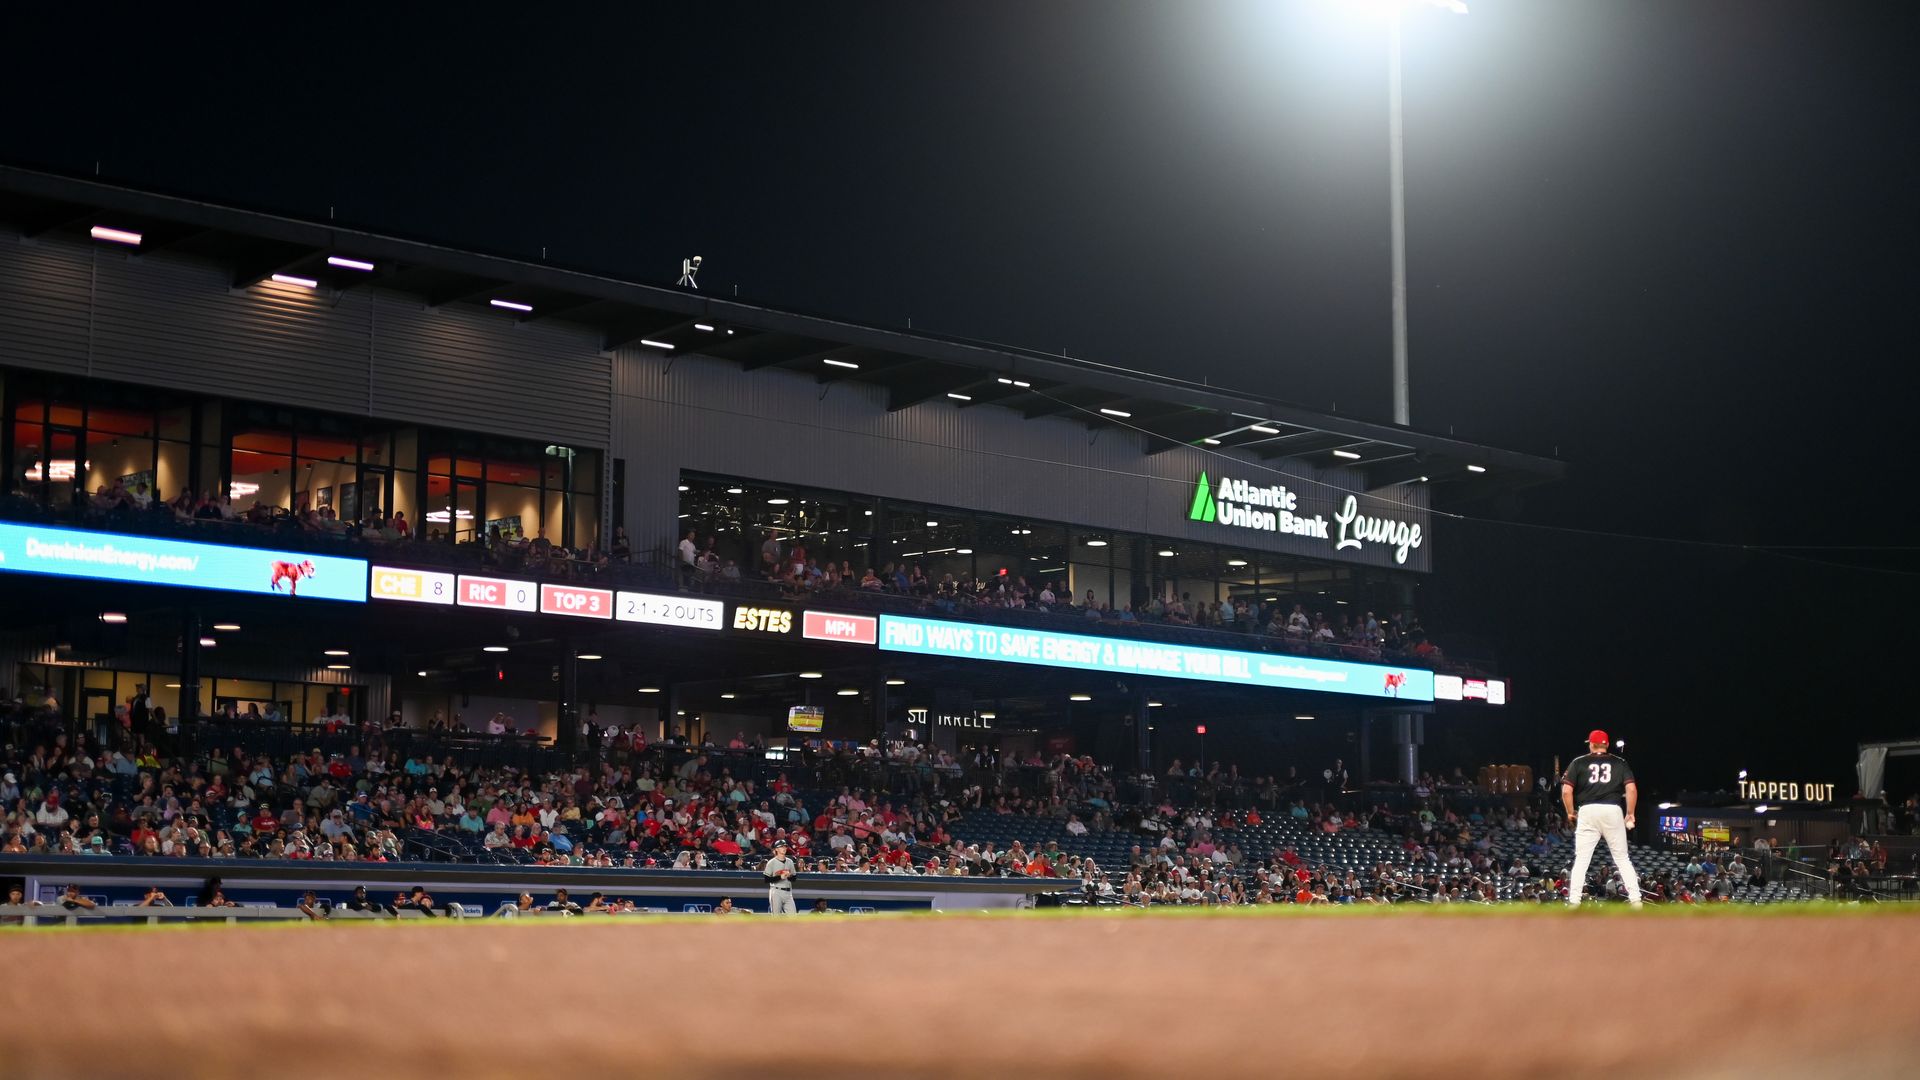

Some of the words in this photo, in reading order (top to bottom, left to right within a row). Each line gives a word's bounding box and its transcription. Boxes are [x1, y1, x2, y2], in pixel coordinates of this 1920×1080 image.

[1217, 477, 1297, 511] Atlantic
[1217, 501, 1277, 532] Union
[1279, 511, 1329, 539] Bank
[1334, 495, 1423, 565] Lounge
[380, 574, 416, 595] CHE
[434, 581, 443, 595] 8
[469, 583, 497, 602] RIC
[517, 589, 526, 603] 0
[553, 591, 587, 610] TOP
[589, 595, 600, 612] 3
[663, 604, 670, 618] 2
[675, 605, 714, 622] OUTS
[733, 607, 792, 634] ESTES
[825, 619, 856, 637] MPH
[885, 620, 922, 647] FIND
[926, 623, 974, 652] WAYS
[976, 630, 997, 654] TO
[999, 633, 1040, 659] SAVE
[1042, 636, 1100, 665] ENERGY
[1102, 642, 1115, 666] &
[1116, 644, 1182, 673] MANAGE
[1183, 651, 1221, 676] YOUR
[1222, 655, 1252, 679] BILL
[1588, 763, 1612, 784] 33
[1738, 780, 1798, 801] TAPPED
[1805, 783, 1835, 802] OUT
